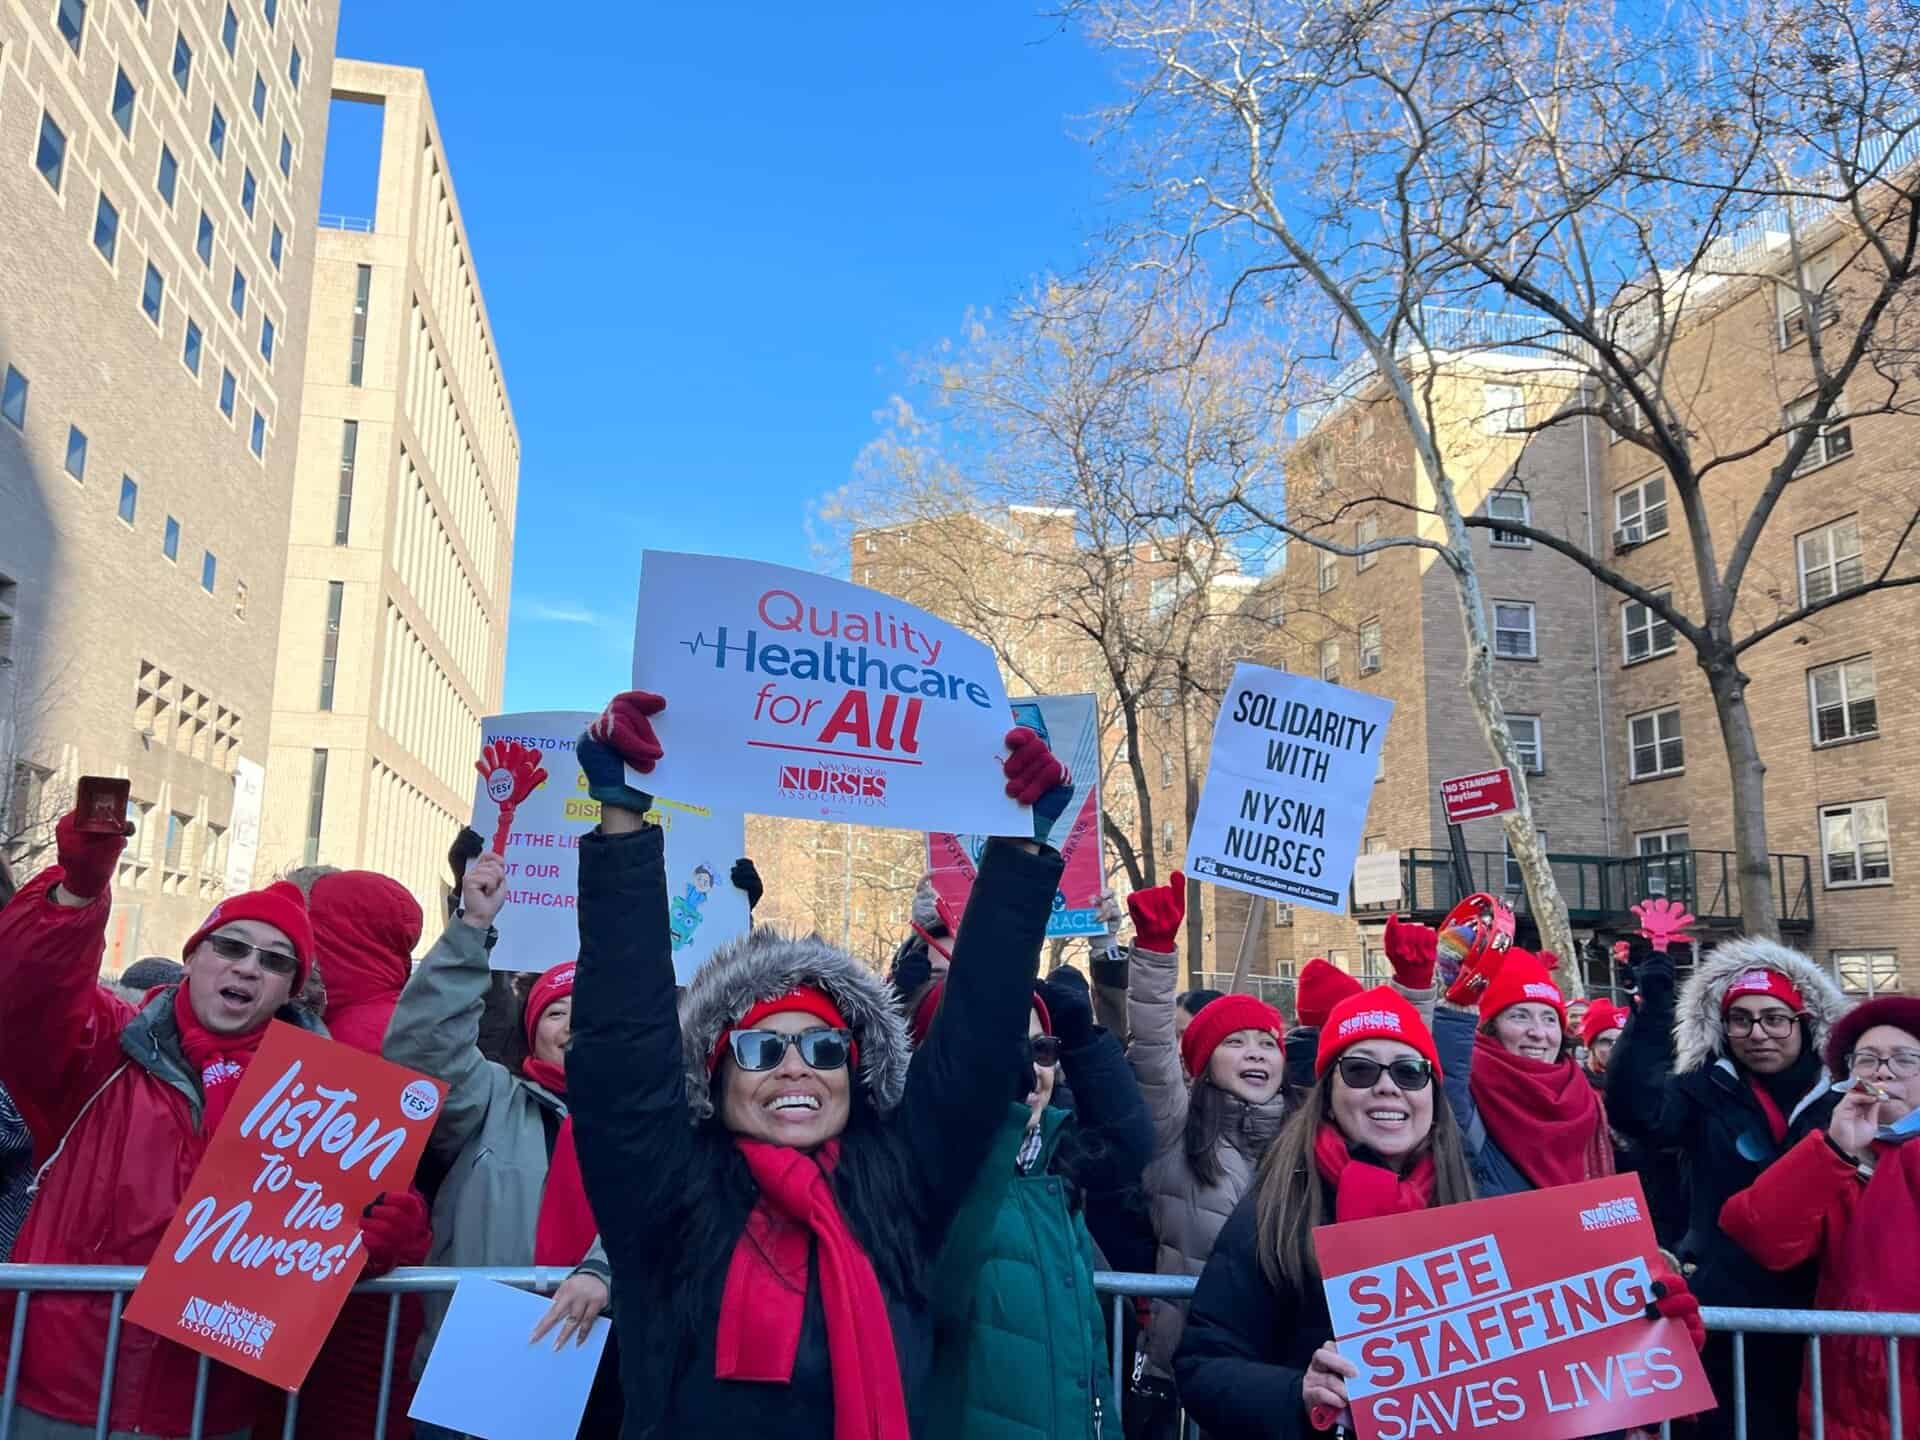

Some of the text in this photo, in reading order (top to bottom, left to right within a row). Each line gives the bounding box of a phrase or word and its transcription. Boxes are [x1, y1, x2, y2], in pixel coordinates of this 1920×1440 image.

[758, 590, 942, 666] Quality
[715, 627, 992, 708] Healthcare
[753, 683, 923, 753] for All
[1233, 690, 1377, 754] SOLIDARITY
[538, 738, 556, 749] TO
[1266, 739, 1330, 783] WITH
[490, 783, 508, 794] YES
[778, 765, 886, 799] NURSES
[778, 789, 888, 808] ASSOCIATION
[1239, 789, 1325, 838] NYSNA
[525, 833, 554, 847] THE
[1224, 826, 1325, 878] NURSES
[525, 864, 560, 878] OUR
[505, 890, 575, 909] ALTHCAR
[1049, 912, 1096, 930] RACE
[403, 1091, 425, 1111] YES
[1348, 1241, 1500, 1325] SAFE
[177, 1318, 265, 1359] ASSOCIATION
[182, 1296, 274, 1348] NURSES
[1361, 1267, 1646, 1388] STAFFING
[1372, 1346, 1684, 1440] SAVES LIVES
